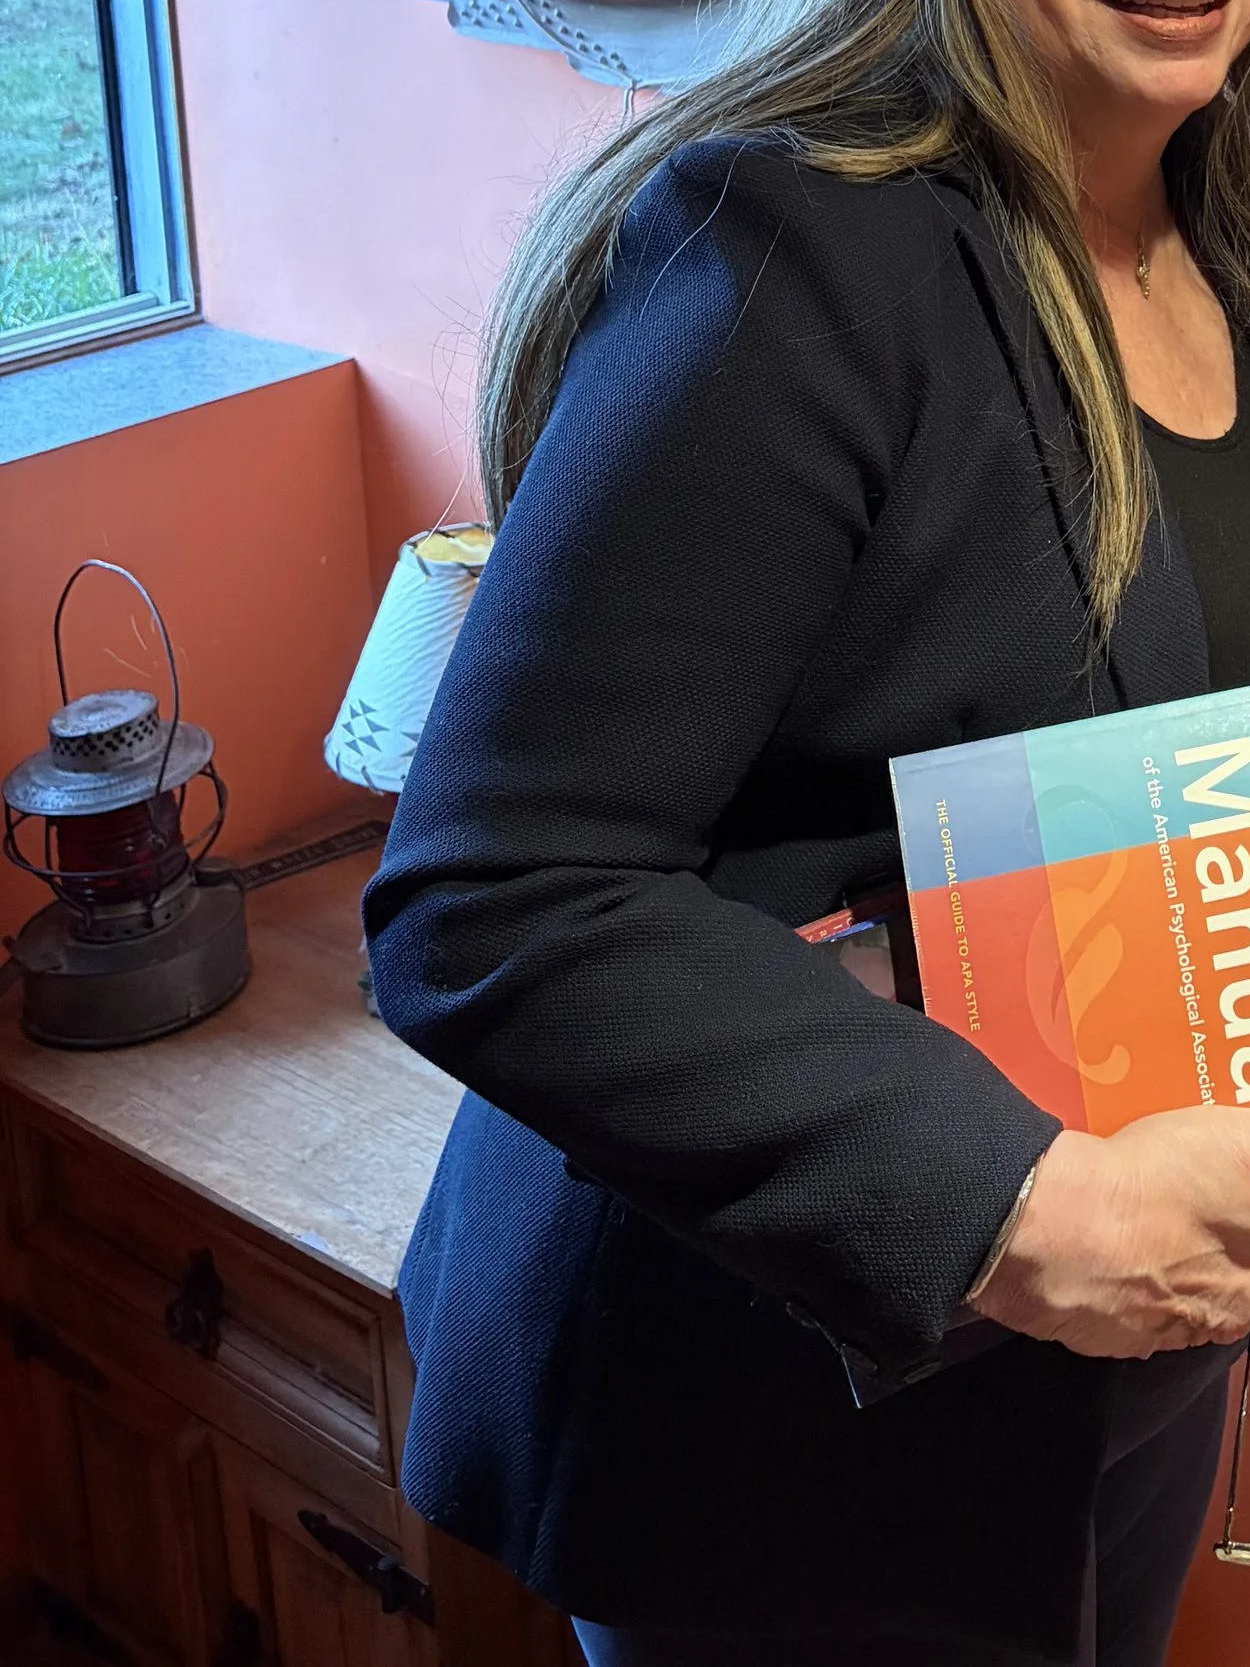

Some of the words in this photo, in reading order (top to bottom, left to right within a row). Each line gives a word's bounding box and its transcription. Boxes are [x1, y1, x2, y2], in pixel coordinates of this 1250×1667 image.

[1142, 756, 1161, 774] of
[936, 799, 949, 824] THE
[1147, 779, 1164, 809] the
[941, 828, 958, 888] OFFICIAL
[1153, 813, 1179, 898] American
[950, 891, 965, 934] GUIDE
[958, 936, 969, 956] TO
[961, 961, 974, 989] APA
[1168, 903, 1206, 1026] Psychological
[965, 991, 981, 1032] STYLE
